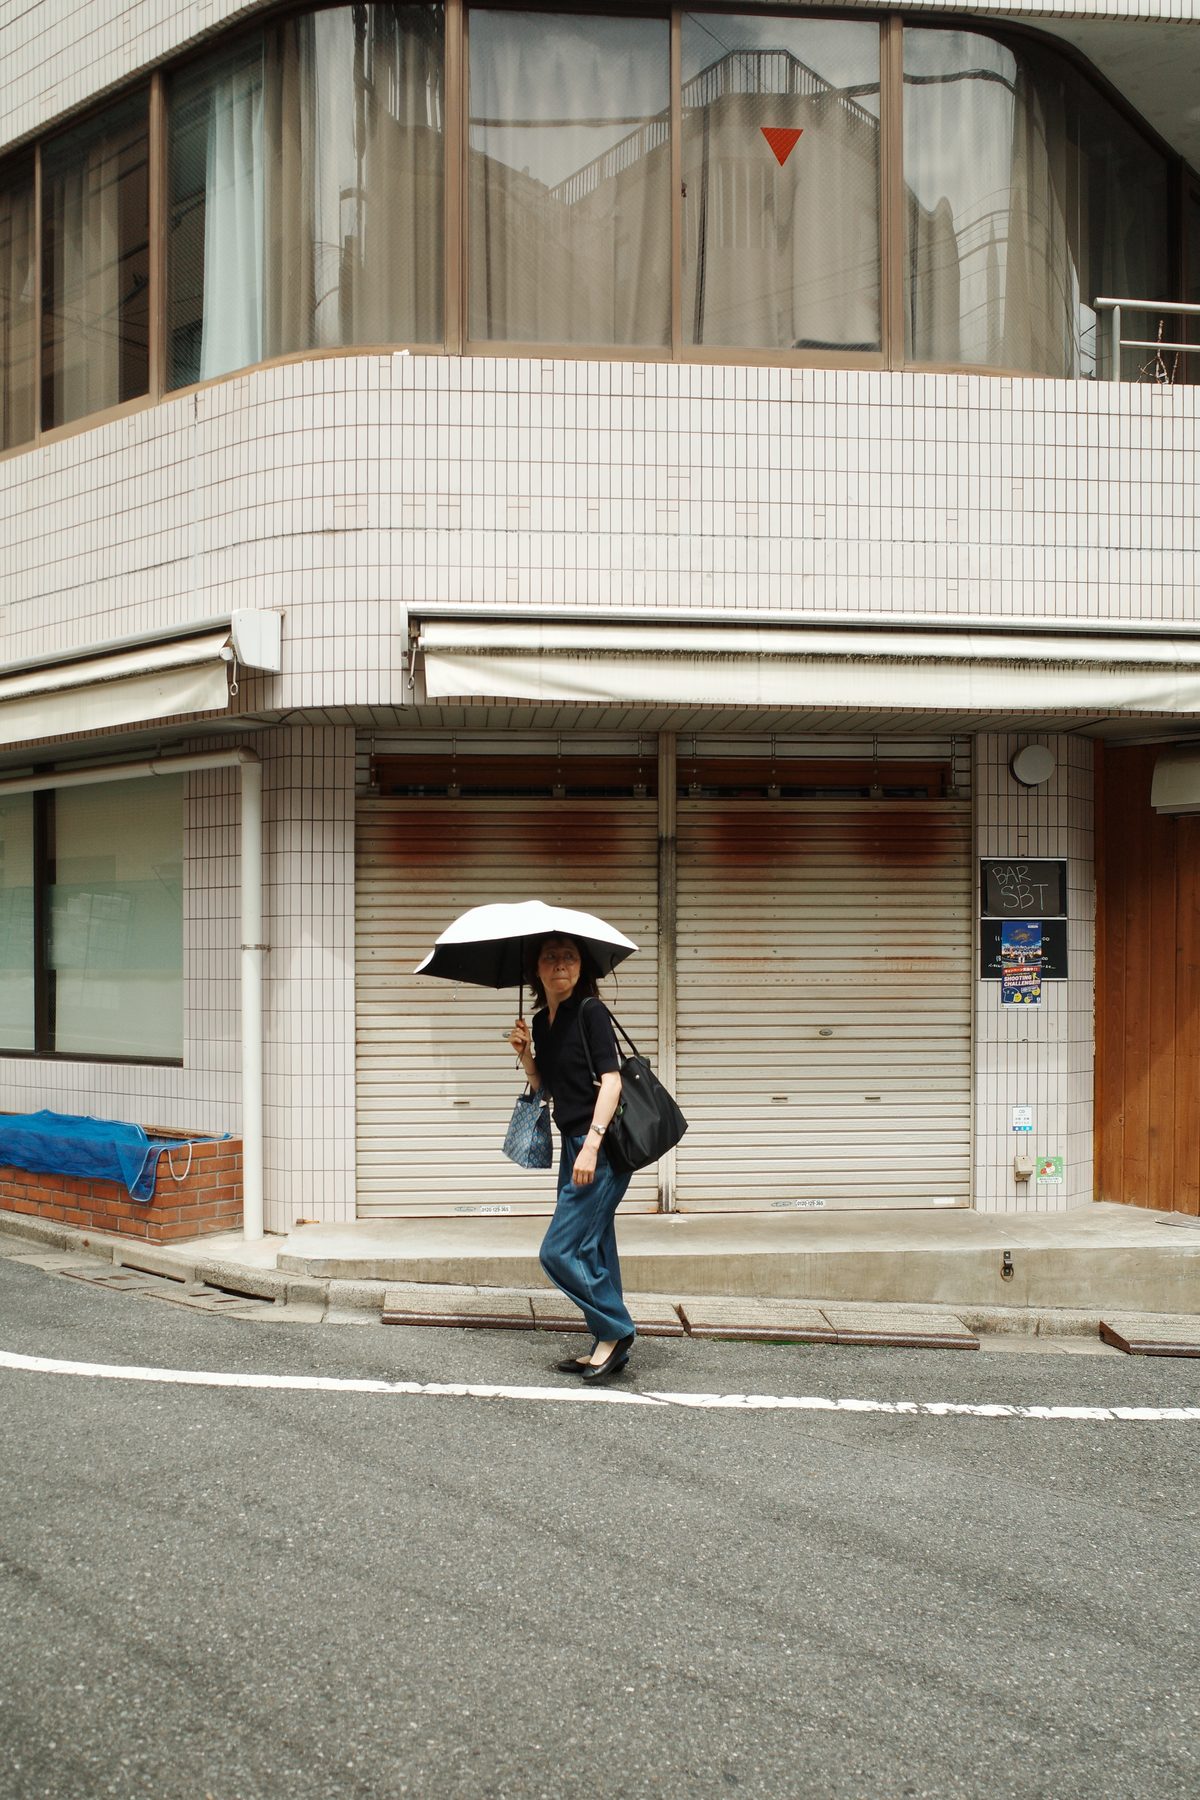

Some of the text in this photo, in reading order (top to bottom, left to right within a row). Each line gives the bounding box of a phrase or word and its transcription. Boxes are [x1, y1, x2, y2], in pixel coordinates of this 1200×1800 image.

[992, 866, 1031, 885] BAR
[1001, 884, 1048, 910] SBT
[1004, 974, 1032, 982] SHOOTING
